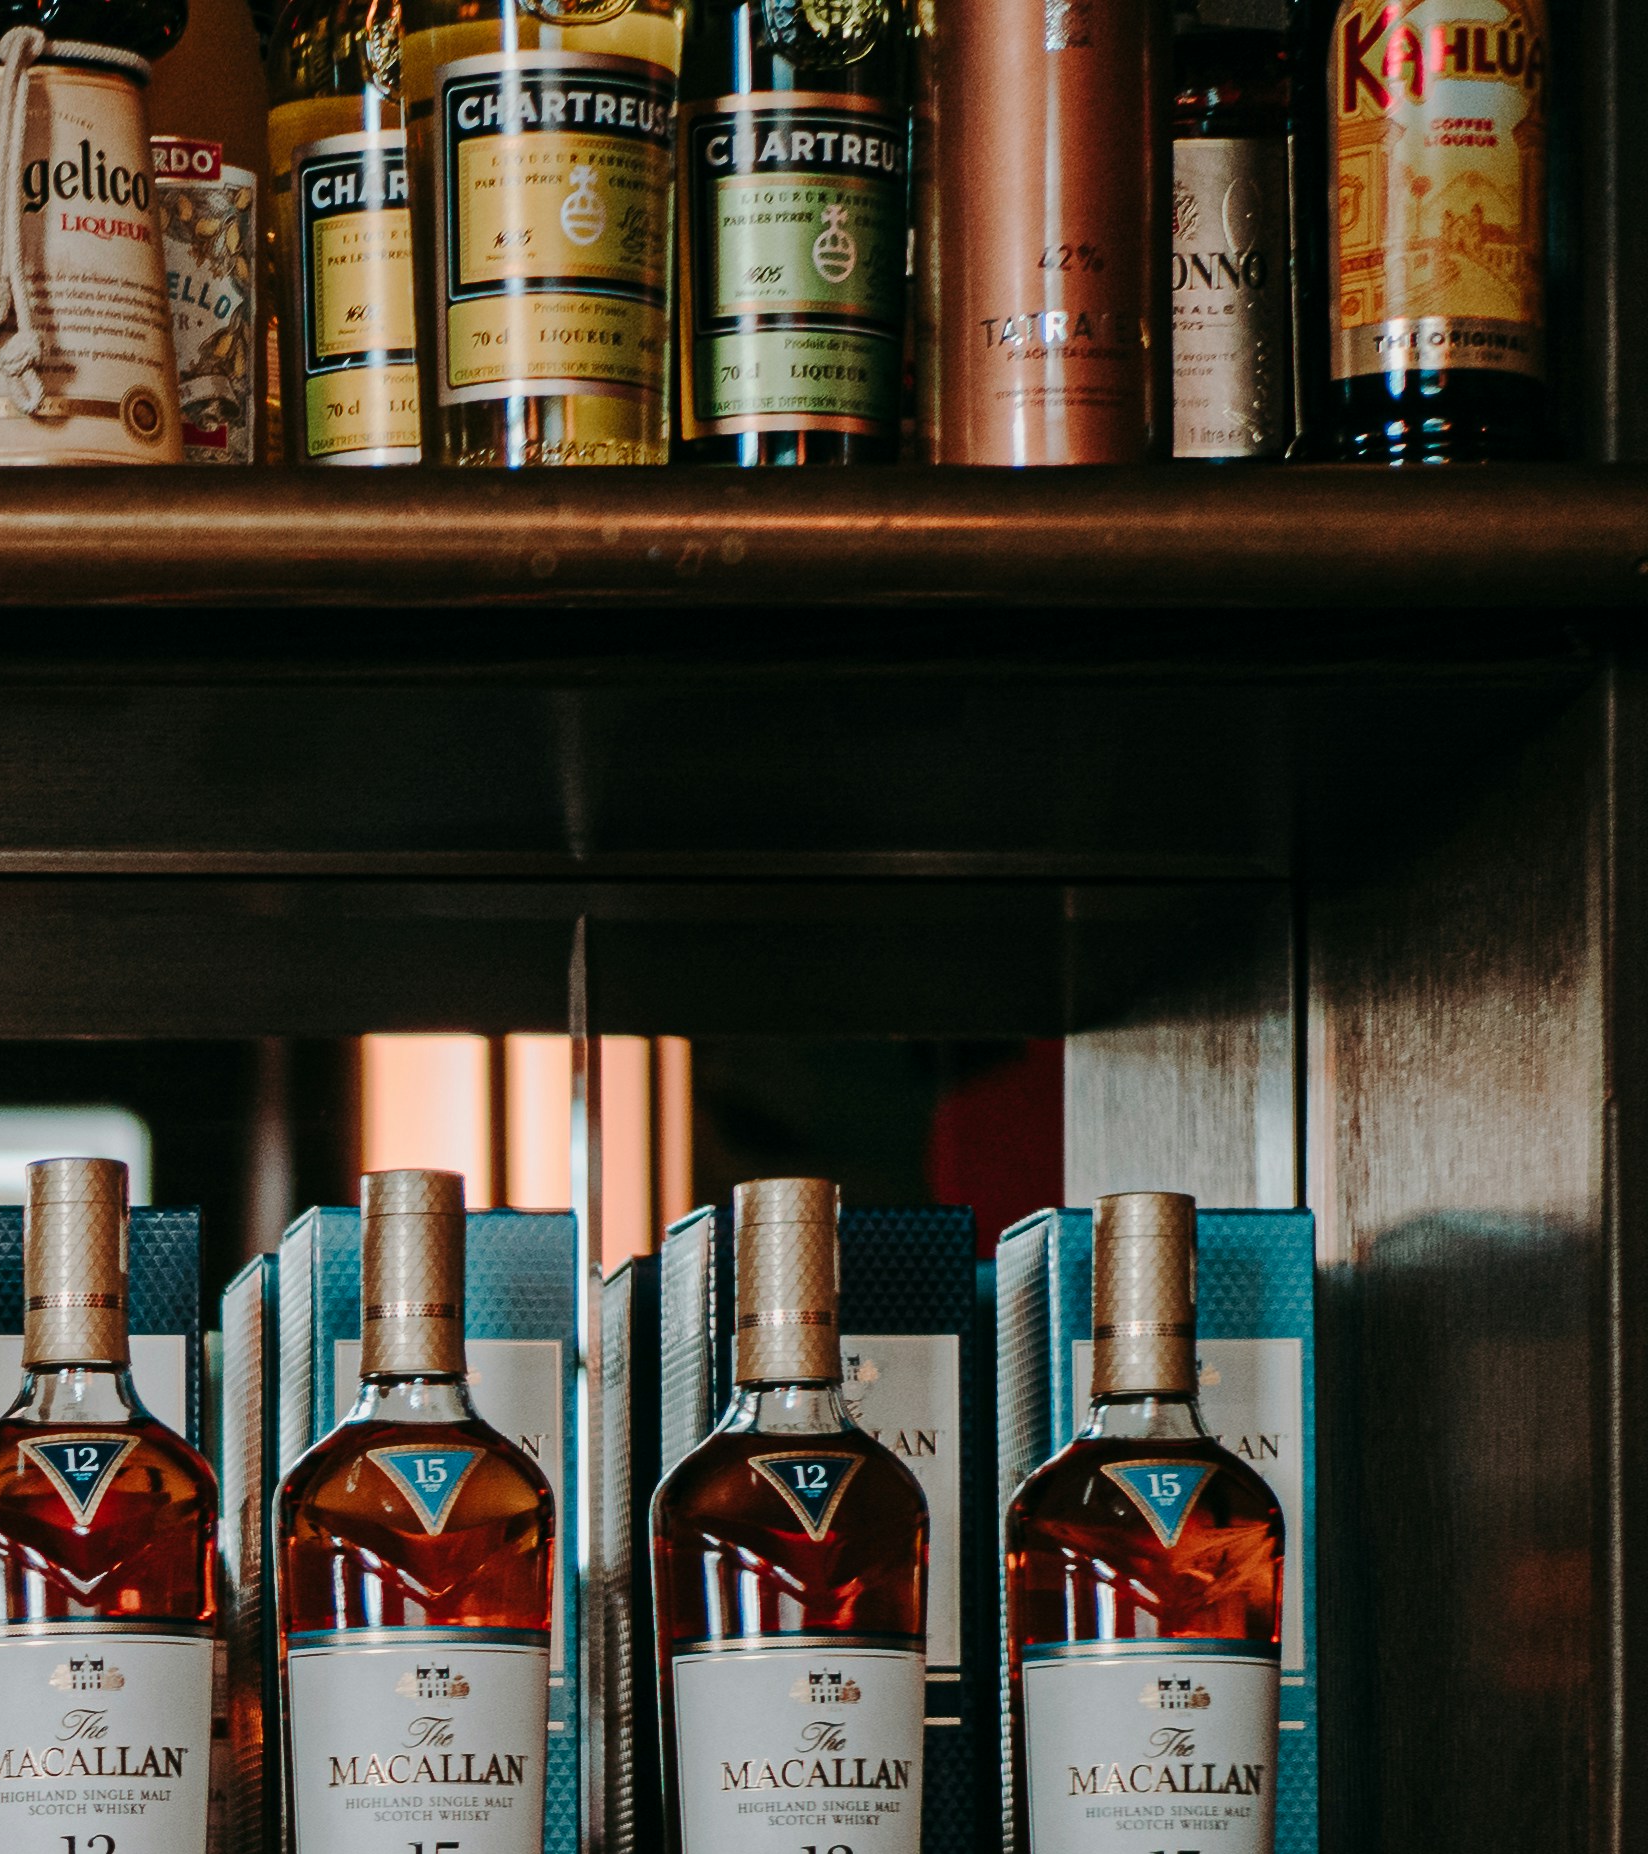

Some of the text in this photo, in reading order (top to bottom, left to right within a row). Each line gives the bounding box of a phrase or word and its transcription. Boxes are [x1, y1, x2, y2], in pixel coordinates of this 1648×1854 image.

[1344, 4, 1542, 113] KAHLÚA
[457, 91, 673, 136] CHARTREUS
[707, 131, 902, 173] CARTREU
[534, 302, 574, 314] Produit
[472, 328, 624, 348] 70 cl LIQUEUR
[721, 364, 868, 384] 70 LIQUEUR
[326, 400, 360, 418] 70 cl
[64, 1447, 99, 1473] 12
[413, 1458, 447, 1482] 15
[793, 1465, 828, 1489] 12
[1149, 1473, 1181, 1497] 15
[55, 1709, 108, 1740] The
[403, 1716, 454, 1748] The
[795, 1722, 846, 1752] The
[1143, 1727, 1194, 1758] The
[329, 1754, 524, 1787] MACALLAN
[722, 1759, 910, 1790] MACALLAN
[1069, 1764, 1262, 1796] MACALLAN
